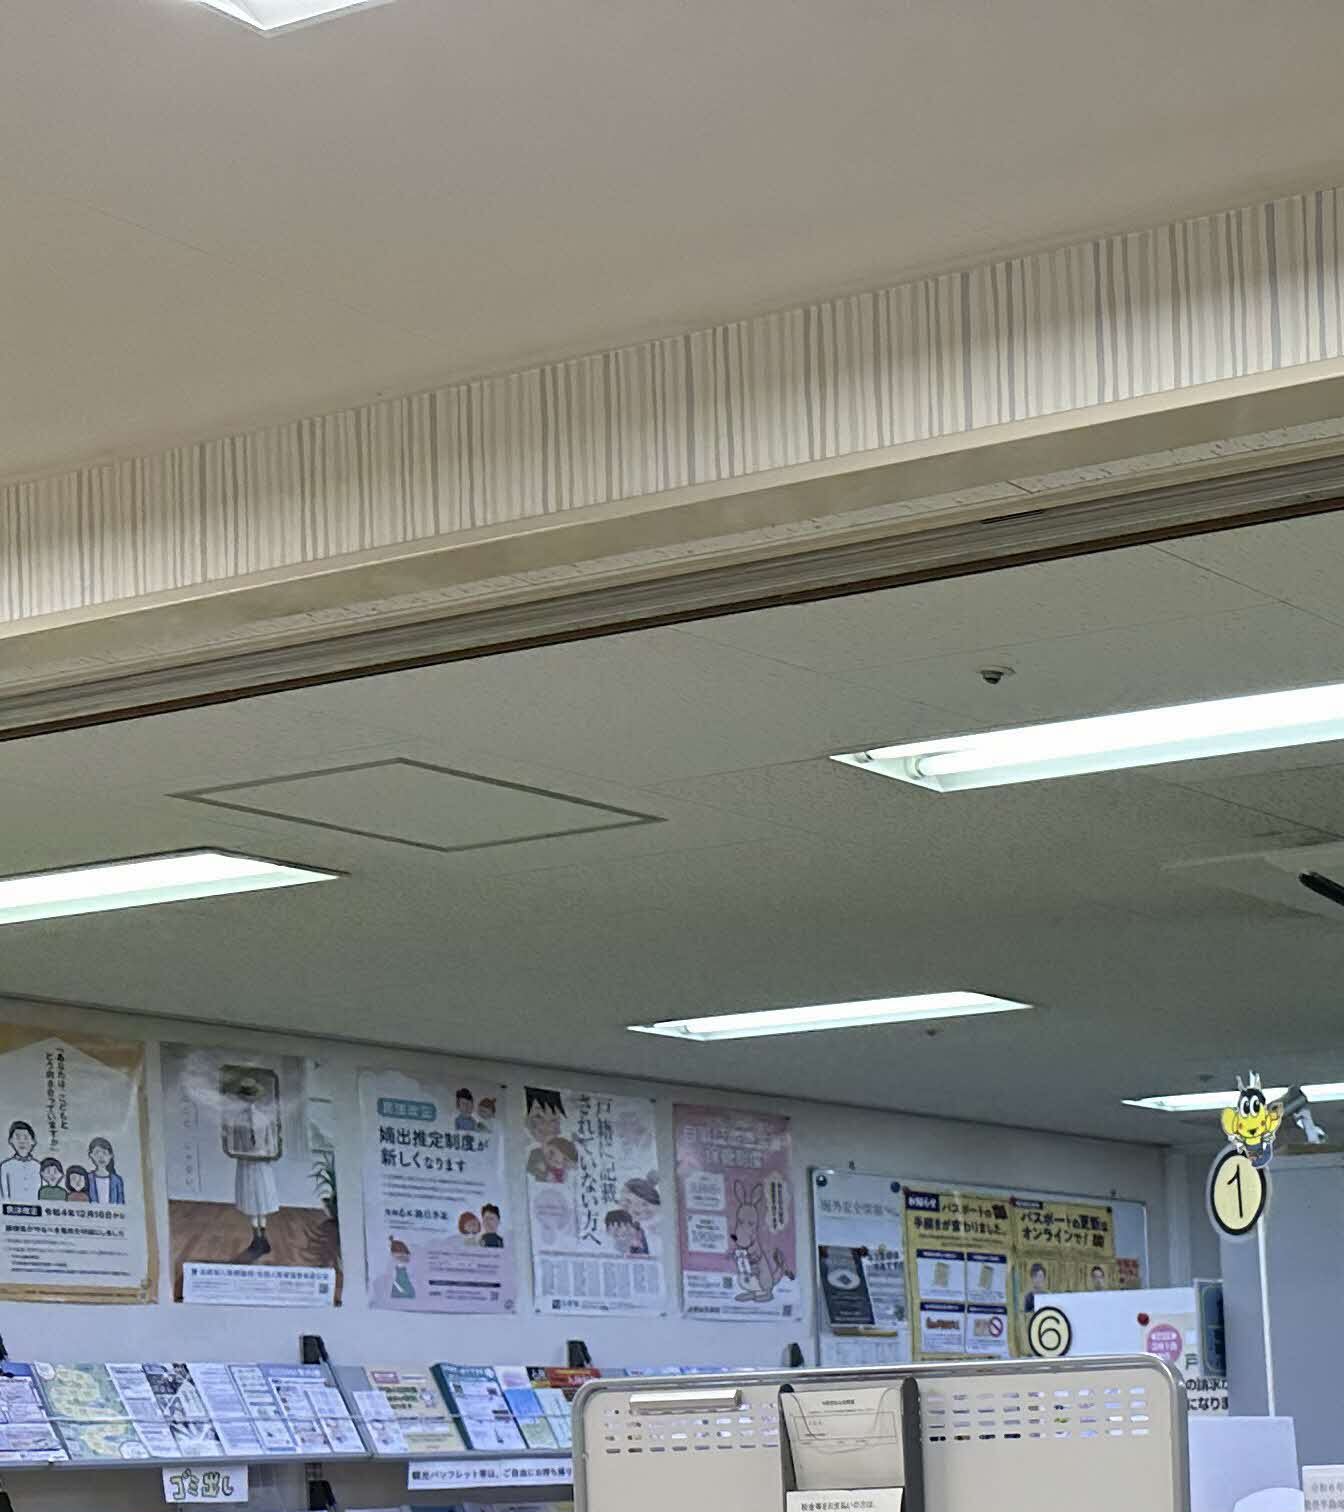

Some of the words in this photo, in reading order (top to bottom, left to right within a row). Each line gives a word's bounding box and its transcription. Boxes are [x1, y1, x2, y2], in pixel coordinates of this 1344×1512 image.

[381, 1147, 466, 1172] 新しくなります
[1227, 1164, 1244, 1219] 1
[1037, 1315, 1062, 1353] 6
[168, 1468, 235, 1501] ゴミ出し
